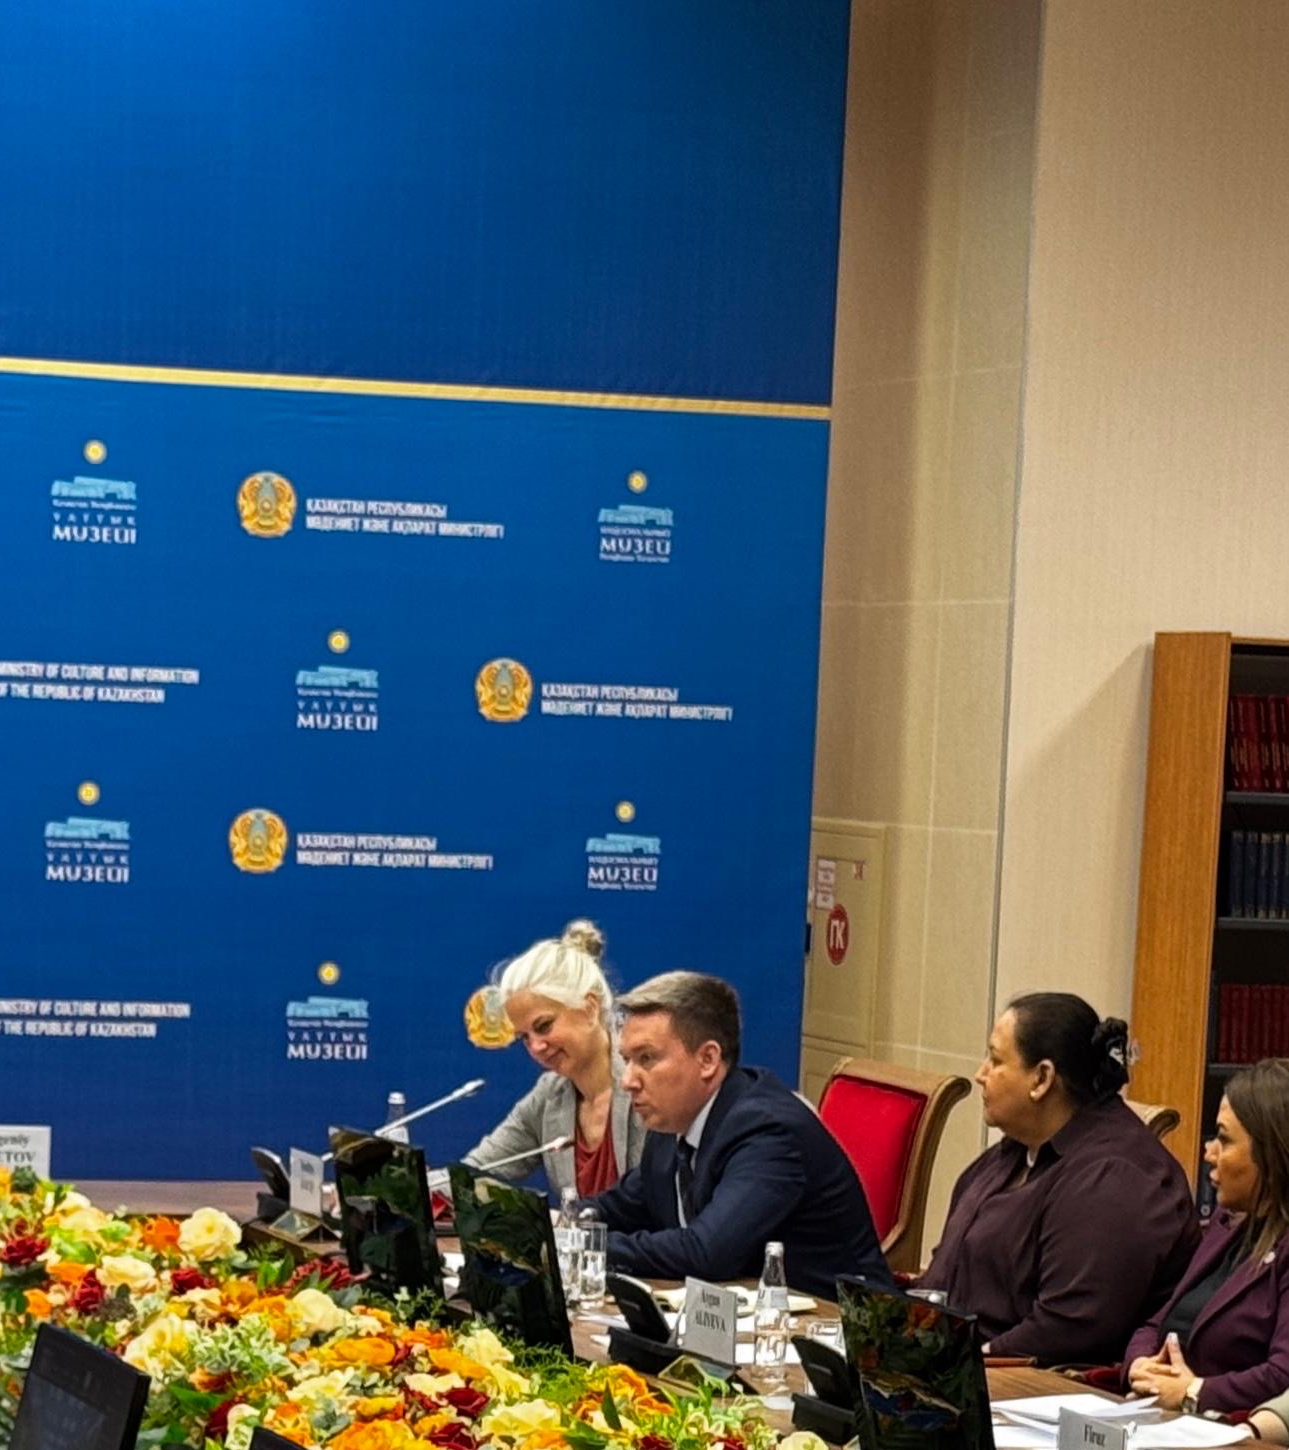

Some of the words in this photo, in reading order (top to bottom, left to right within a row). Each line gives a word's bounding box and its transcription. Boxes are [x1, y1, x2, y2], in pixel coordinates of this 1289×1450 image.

[46, 663, 59, 679] OF
[61, 664, 104, 681] CULTURE
[106, 665, 128, 682] AND
[130, 666, 199, 685] INFORMATION
[10, 683, 30, 698] THE
[32, 684, 82, 701] REPUBLIC
[83, 686, 96, 701] OF
[97, 687, 165, 704] KAZAKHSTAN
[829, 919, 846, 949] ПК
[39, 1000, 52, 1015] OF
[54, 1000, 97, 1016] CULTURE
[99, 1001, 121, 1017] AND
[123, 1002, 191, 1018] INFORMATION
[4, 1020, 24, 1036] THE
[25, 1021, 73, 1037] REPUBLIC
[75, 1022, 88, 1037] OF
[90, 1022, 157, 1038] KAZAKHSTAN
[1084, 1423, 1106, 1448] Firuz
